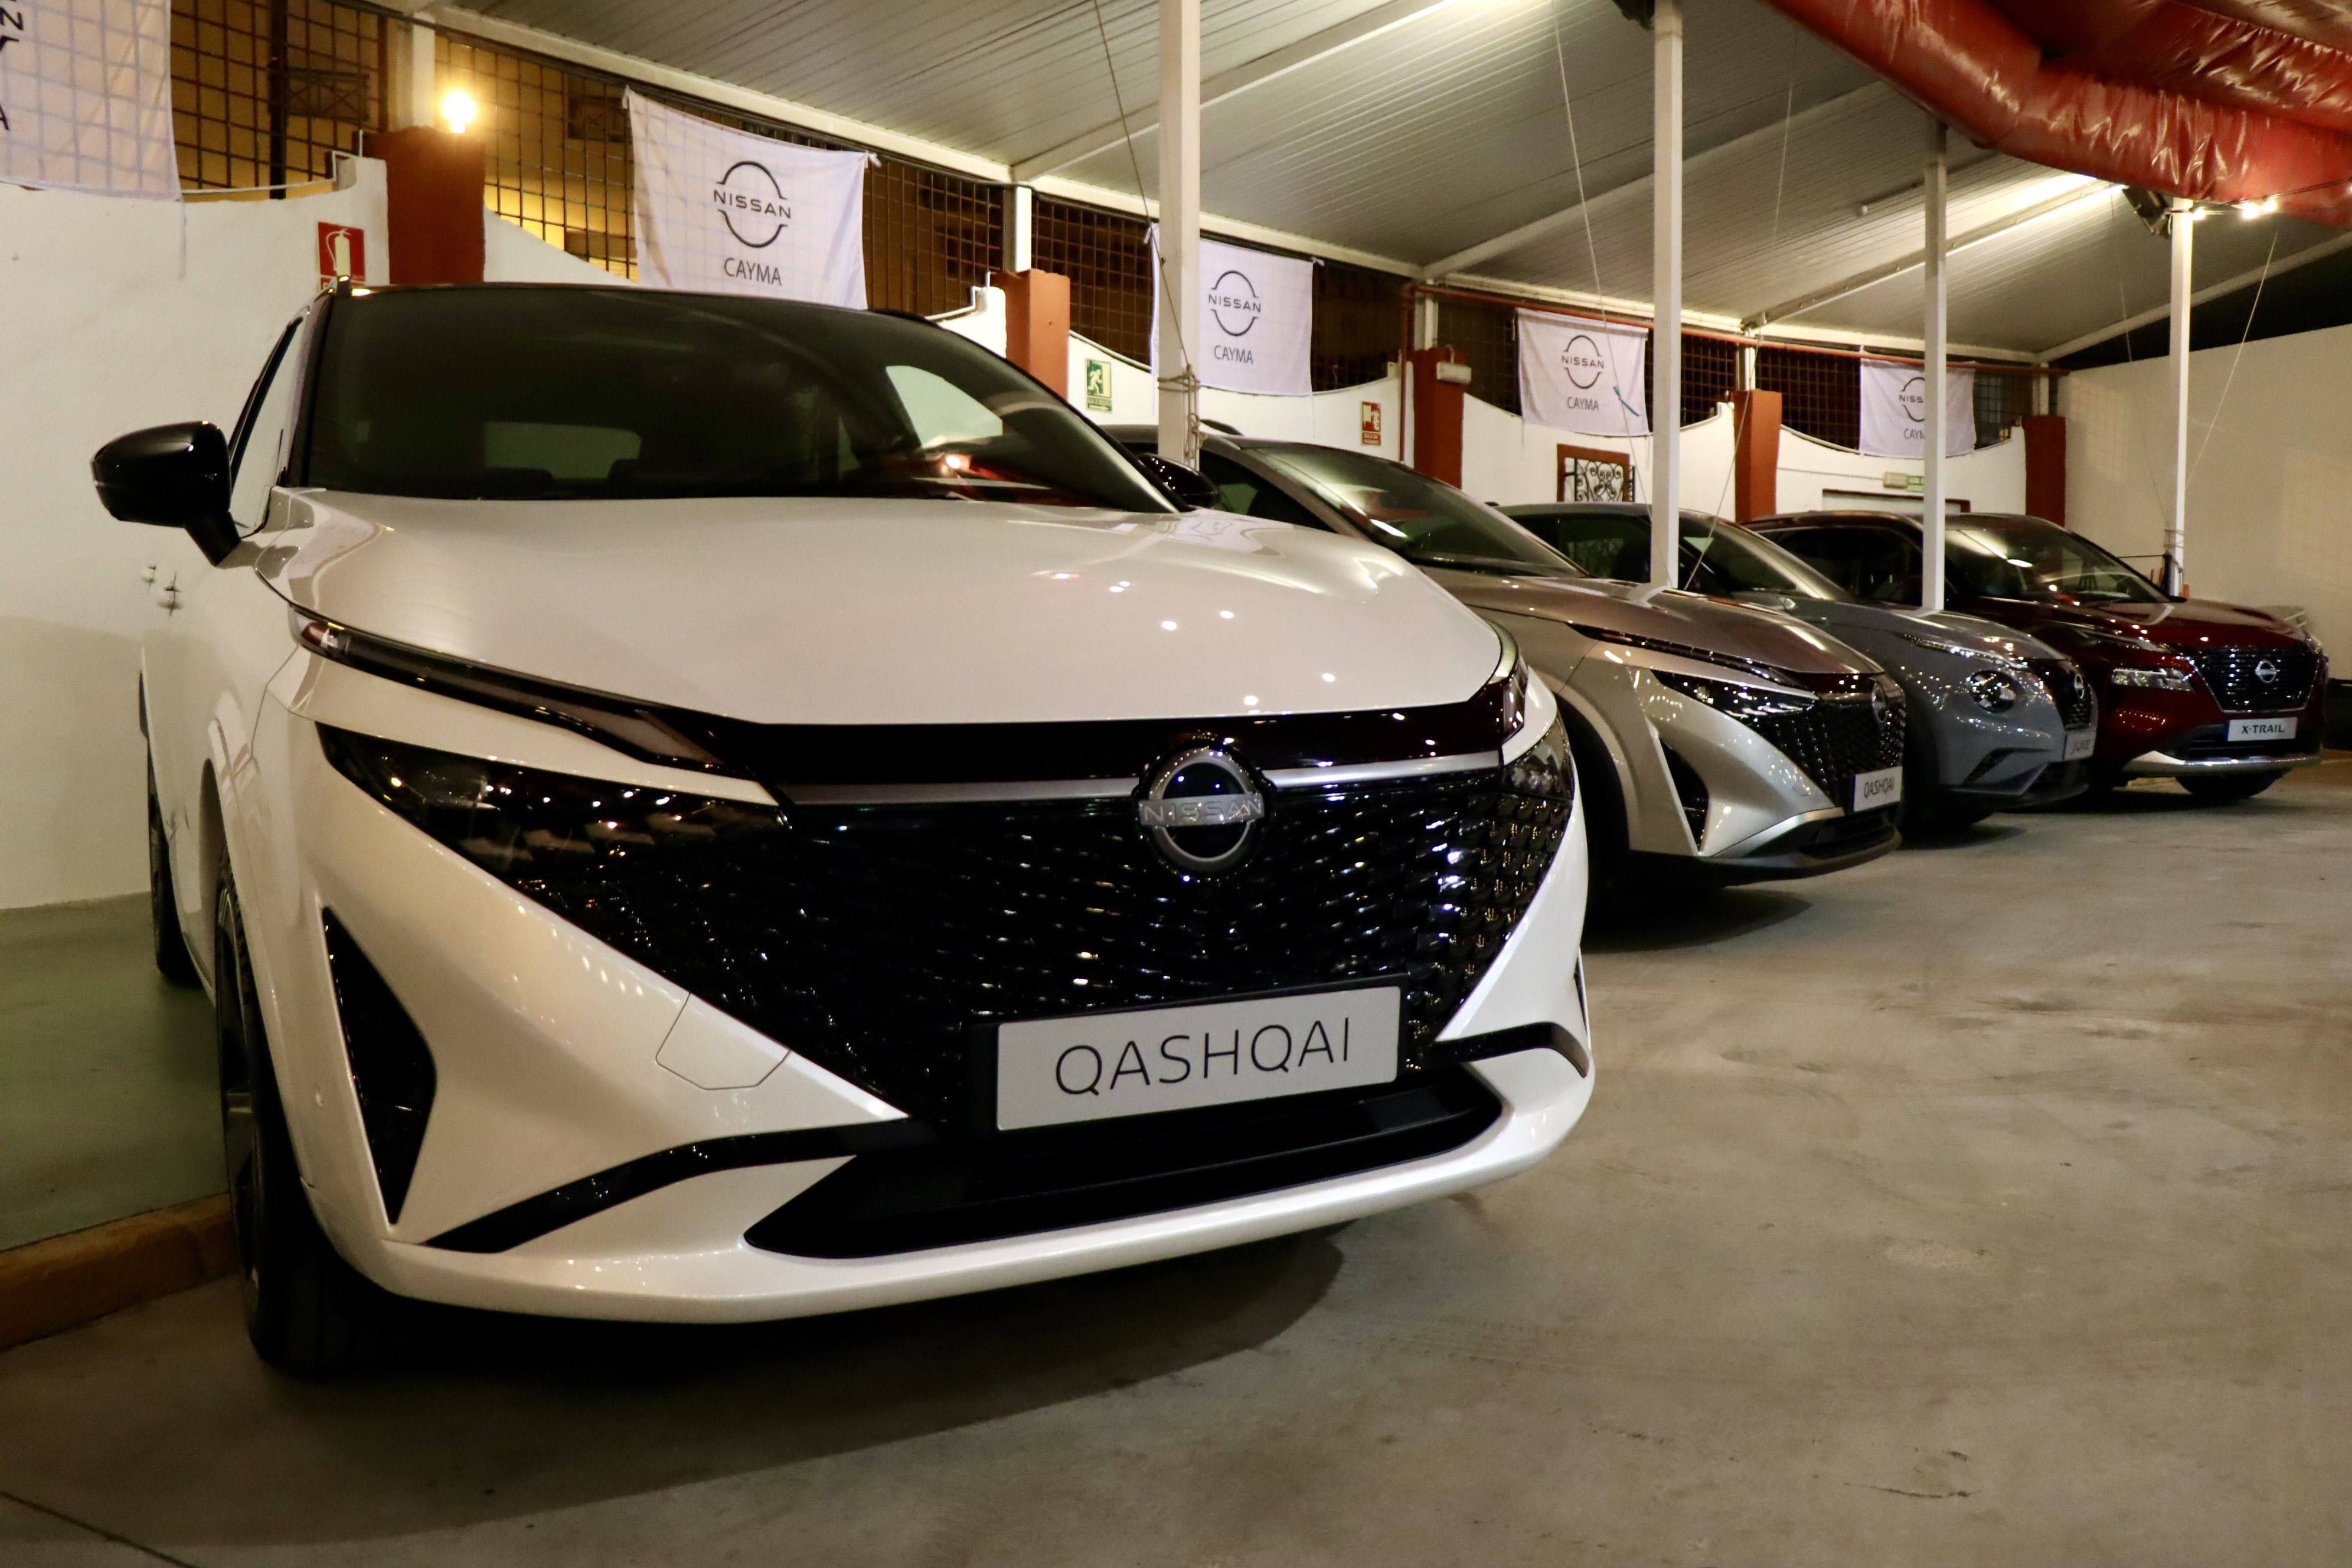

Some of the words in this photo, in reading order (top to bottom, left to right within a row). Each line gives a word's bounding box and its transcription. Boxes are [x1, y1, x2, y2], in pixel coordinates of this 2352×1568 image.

[713, 189, 792, 219] NISSAN
[723, 257, 782, 286] CAYMA
[1208, 293, 1262, 313] NISSAN
[1214, 344, 1253, 364] CAYMA
[1562, 355, 1605, 369] NISSAN
[1567, 396, 1599, 411] CAYMA
[1899, 394, 1924, 403] NISS
[2241, 724, 2285, 734] X-TRAIL
[1864, 776, 1894, 799] QASHQAI
[1144, 799, 1262, 822] NISSAN
[1056, 1017, 1350, 1096] QASHQAI
